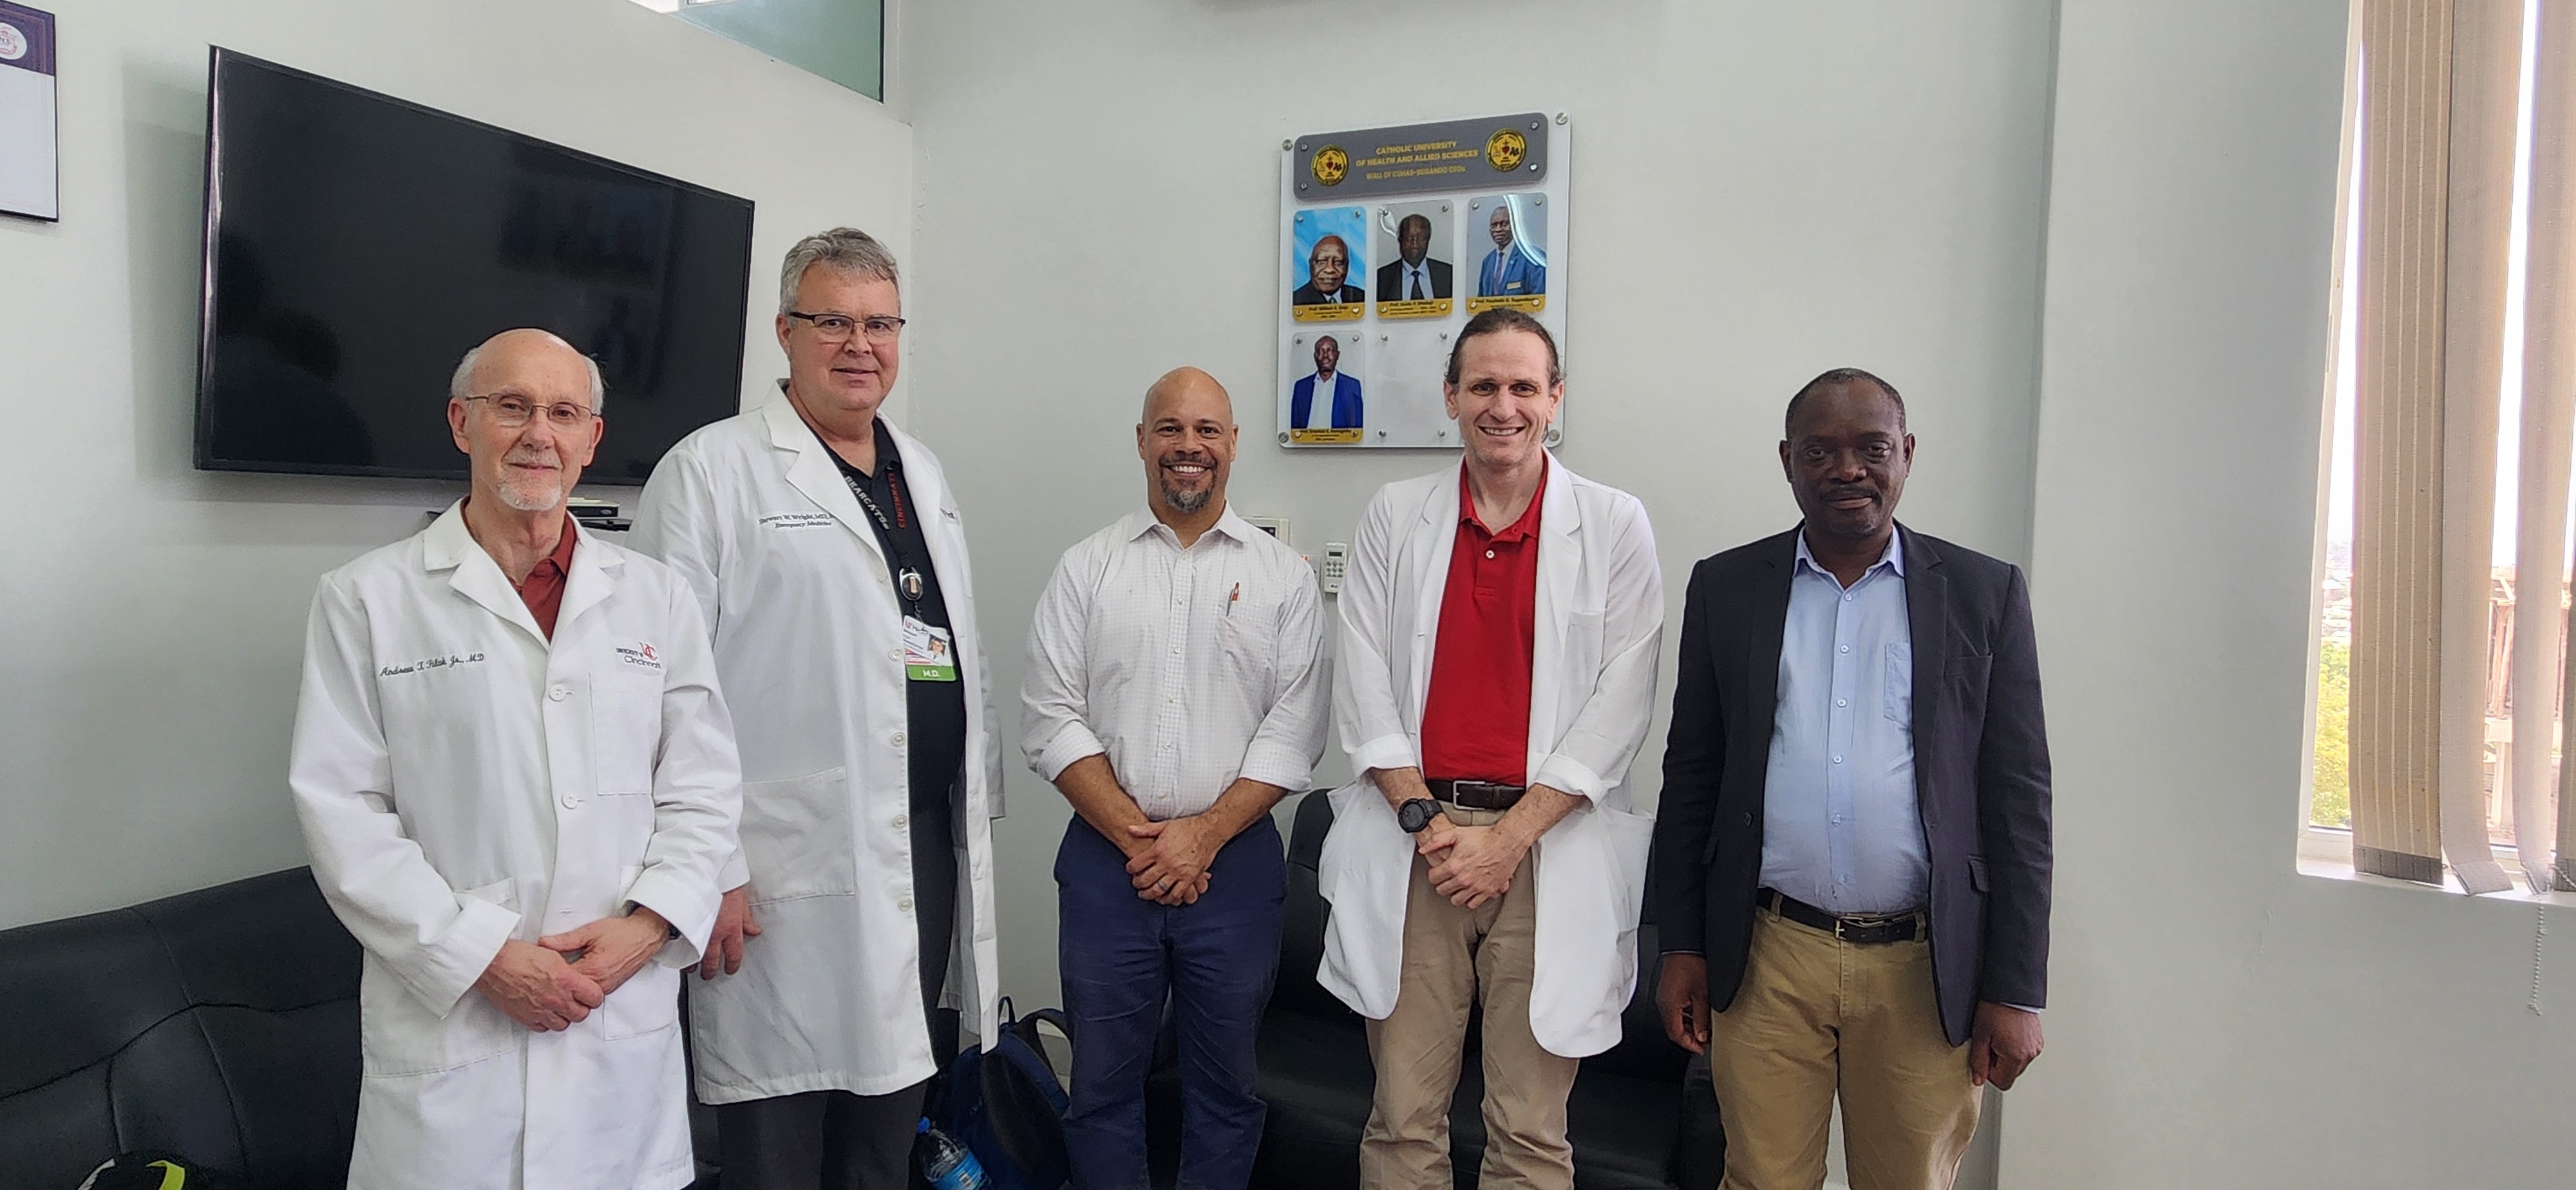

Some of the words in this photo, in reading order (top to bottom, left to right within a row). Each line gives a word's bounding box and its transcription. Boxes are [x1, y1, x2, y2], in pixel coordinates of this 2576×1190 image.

[1376, 145, 1412, 155] CATHOLIC
[1414, 140, 1457, 151] UNIVERSITY
[1367, 157, 1395, 165] HEALTH
[1396, 155, 1413, 164] AND
[1414, 153, 1441, 162] ALLIED
[1442, 149, 1479, 160] SCIENCES
[888, 472, 907, 528] CINCINNATI
[923, 670, 940, 678] M.D.
